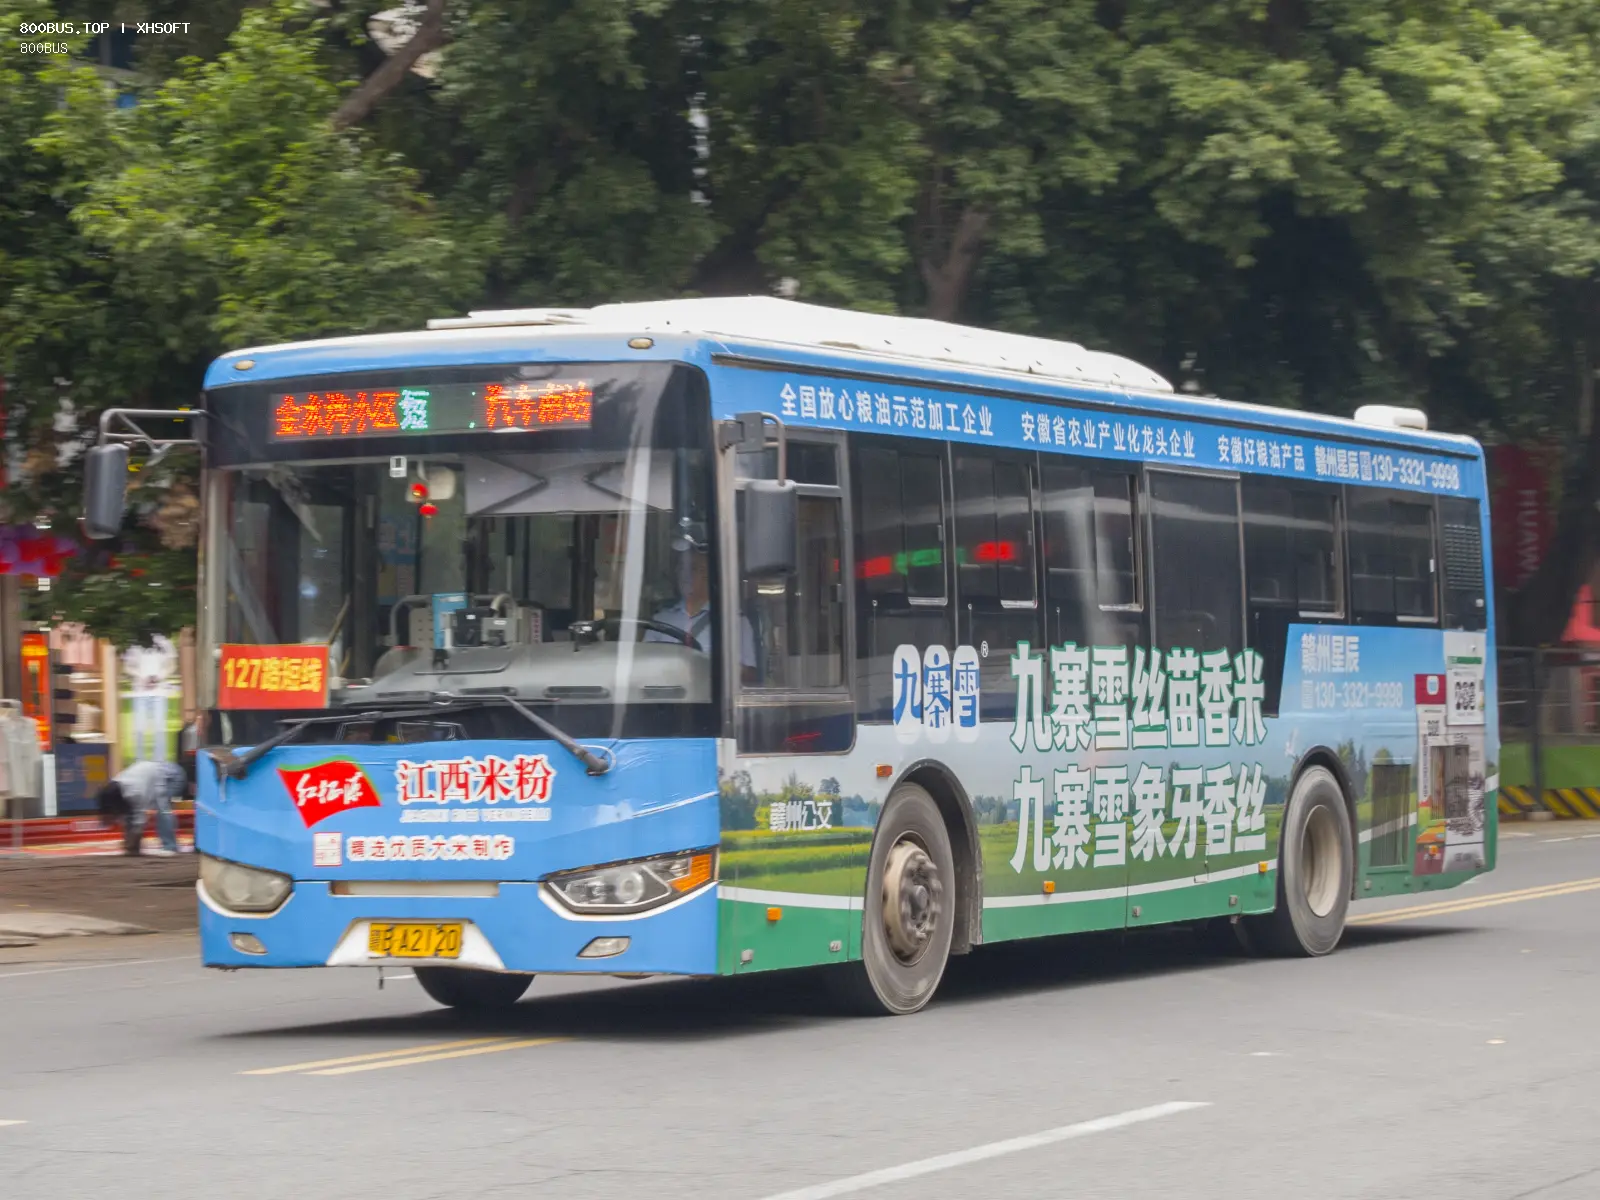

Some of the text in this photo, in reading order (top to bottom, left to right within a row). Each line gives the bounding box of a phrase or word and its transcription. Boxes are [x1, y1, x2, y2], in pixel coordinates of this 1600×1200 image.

[779, 382, 994, 437] 全国放心粮油示范加工企业
[1021, 411, 1196, 459] 安徽省农业产业化龙头企业
[1218, 433, 1305, 472] 安徽好粮油产品
[223, 657, 323, 692] 127路短线
[893, 652, 981, 730] 九寨雪
[1010, 640, 1268, 753] 九寨雪丝苗香米
[397, 756, 555, 803] 江西米粉
[769, 800, 833, 832] 赣州公交
[1010, 761, 1268, 874] 九寨雪象牙香丝
[348, 836, 512, 859] 精选优质大米制作
